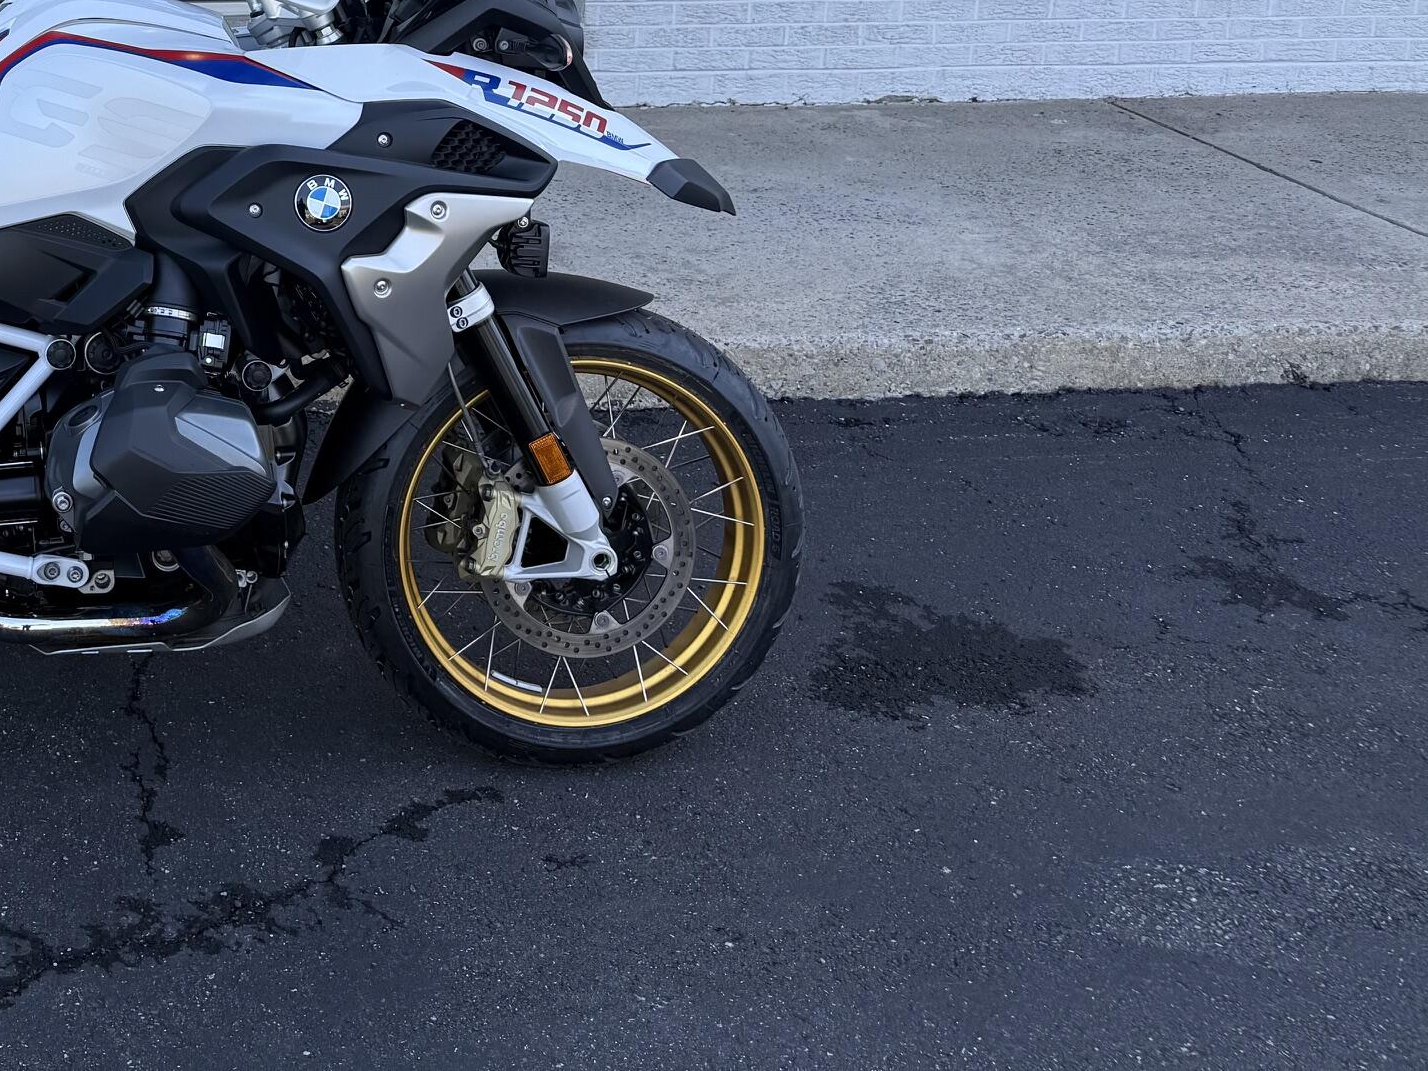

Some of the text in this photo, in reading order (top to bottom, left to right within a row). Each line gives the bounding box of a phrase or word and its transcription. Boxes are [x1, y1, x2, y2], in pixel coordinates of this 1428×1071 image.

[508, 80, 608, 136] 1250
[307, 177, 349, 201] BMW
[487, 512, 508, 561] brembo
